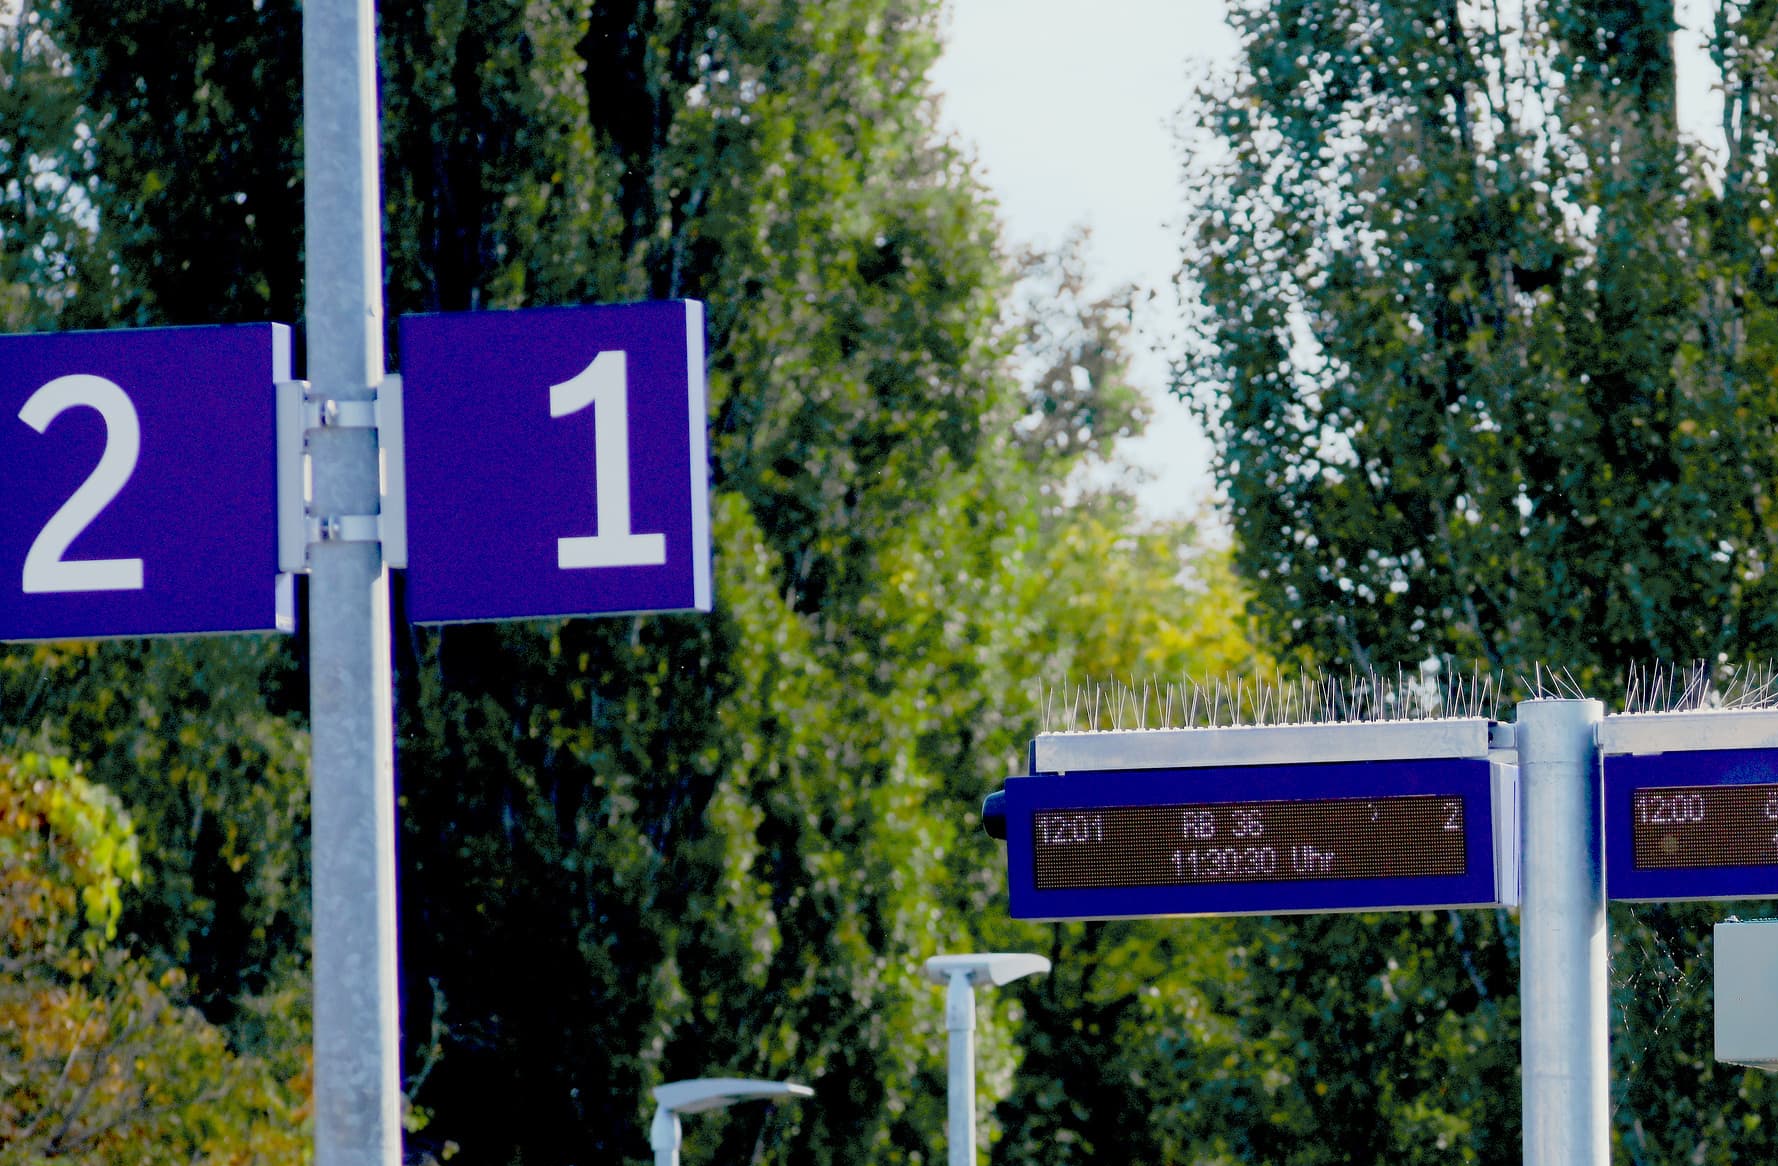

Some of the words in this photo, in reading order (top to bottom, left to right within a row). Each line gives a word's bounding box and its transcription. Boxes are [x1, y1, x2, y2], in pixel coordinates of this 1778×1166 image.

[549, 349, 667, 569] 1
[17, 373, 144, 593] 2
[1038, 814, 1102, 844] 12:01
[1183, 810, 1215, 839] RB
[1231, 808, 1264, 837] 36
[1442, 802, 1459, 830] 2
[1637, 794, 1703, 823] 12:00
[1171, 847, 1277, 876] 11:30:30
[1291, 845, 1335, 873] Uhr
